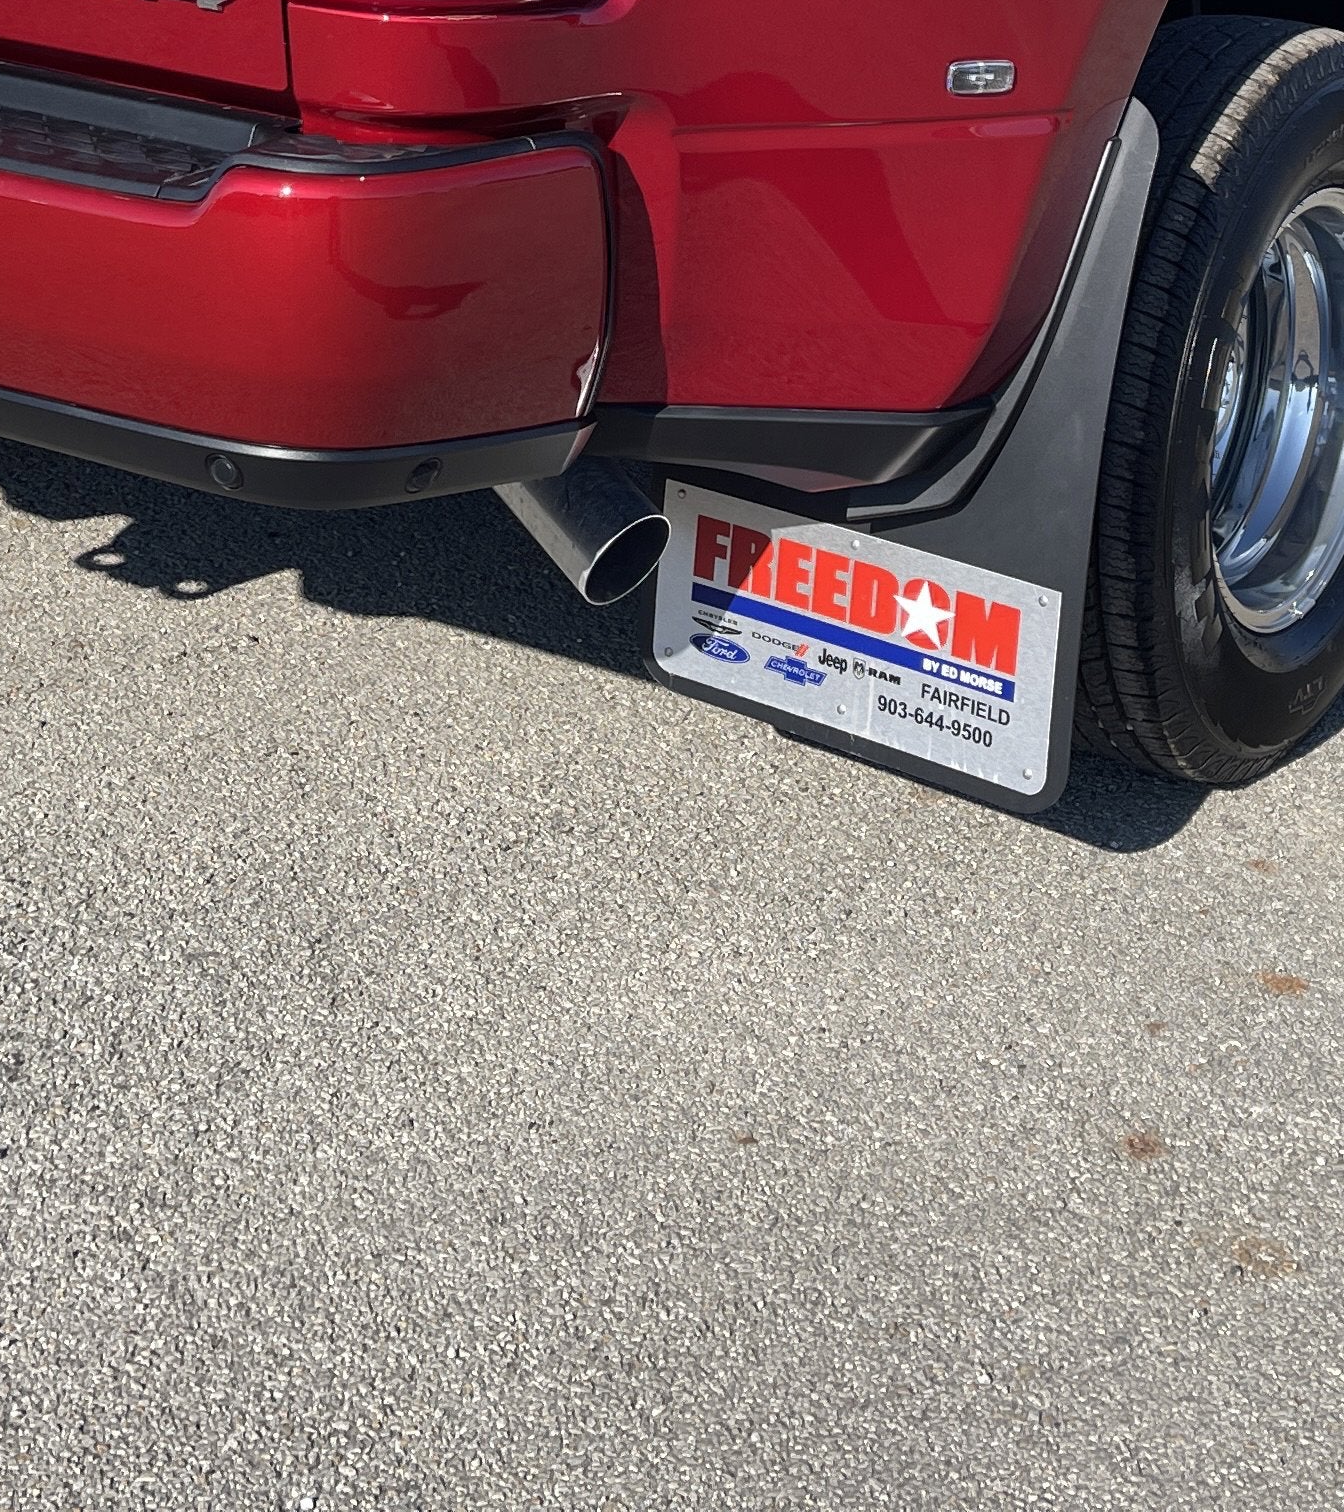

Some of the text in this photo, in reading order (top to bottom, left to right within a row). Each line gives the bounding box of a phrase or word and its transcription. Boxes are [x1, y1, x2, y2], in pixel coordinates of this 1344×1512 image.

[692, 513, 1022, 677] FREEDOM
[698, 609, 738, 626] CHRYSLER
[702, 637, 737, 661] Ford
[751, 631, 799, 652] DODGE
[770, 660, 821, 685] CHEVROLET
[818, 648, 848, 675] Jeep
[868, 668, 902, 686] RAM
[922, 657, 1003, 695] BY ED MORSE
[920, 683, 1011, 727] FAIRFIELD
[877, 695, 993, 748] 903-644-9500
